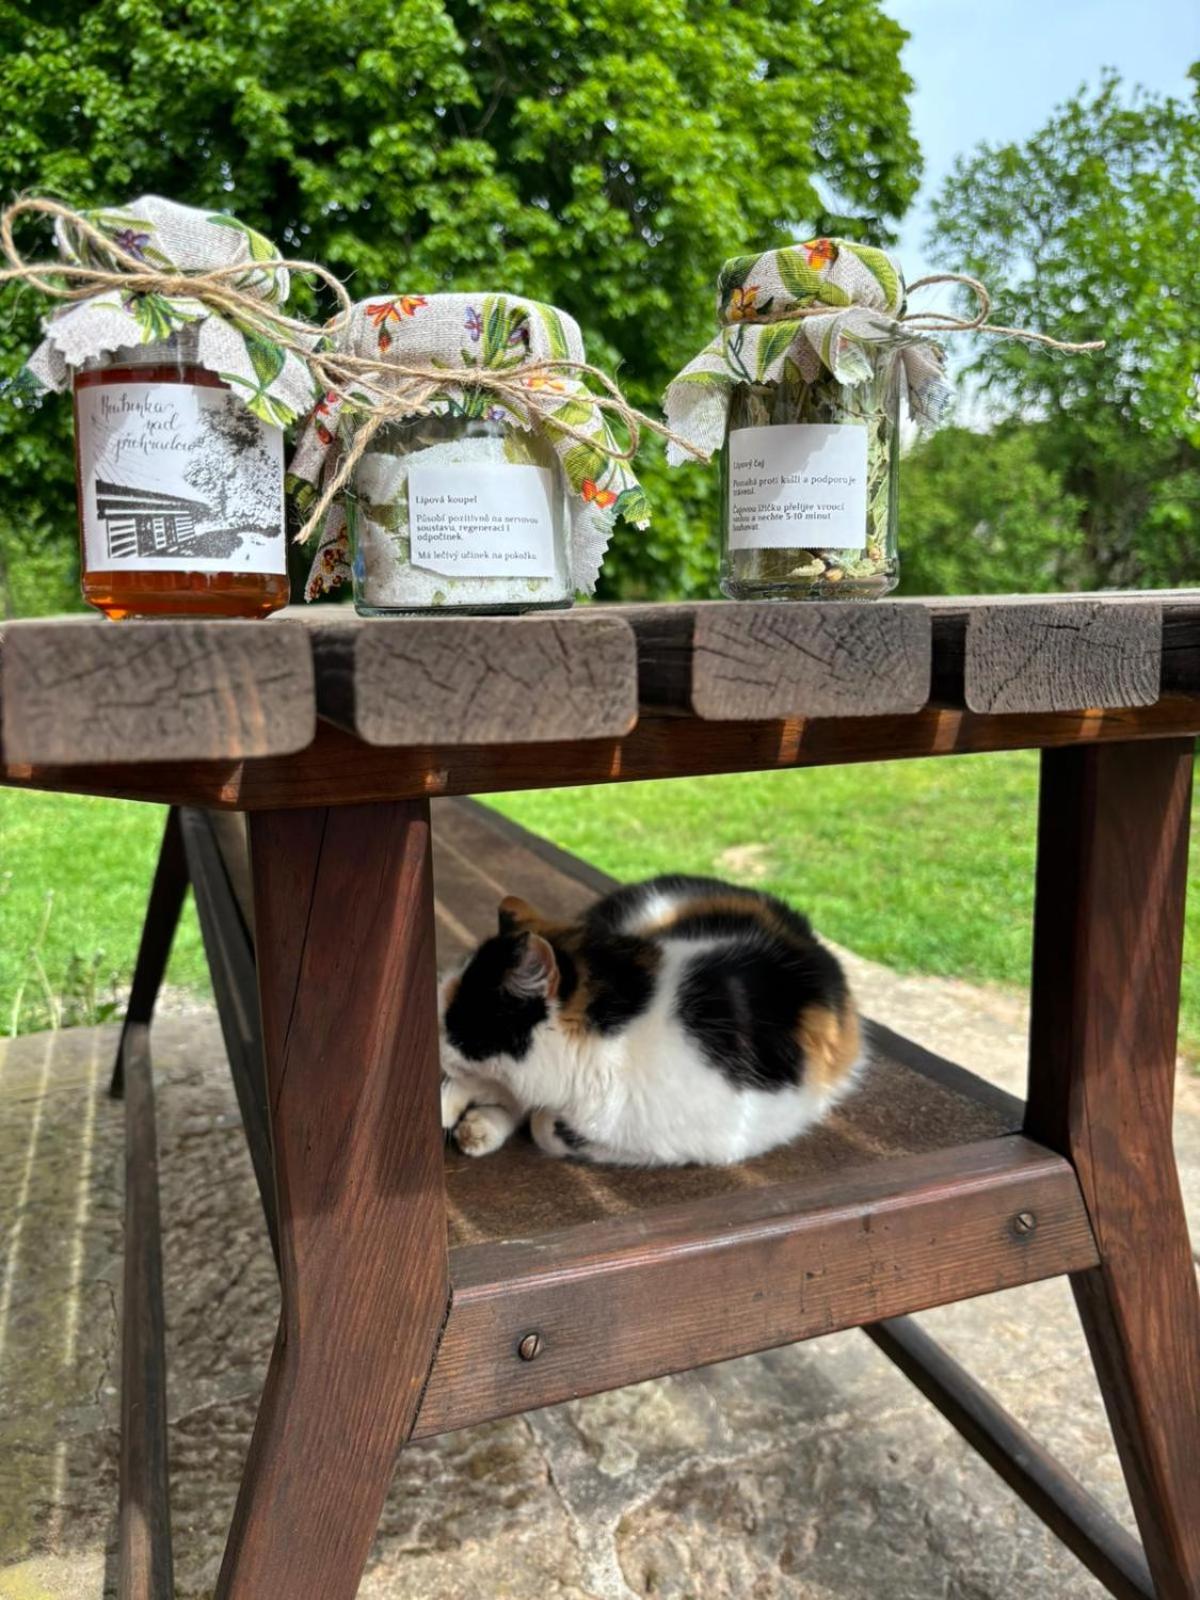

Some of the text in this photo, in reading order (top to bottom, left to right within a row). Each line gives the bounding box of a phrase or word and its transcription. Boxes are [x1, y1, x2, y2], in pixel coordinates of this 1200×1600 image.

[759, 477, 779, 487] proti
[811, 475, 856, 486] podporuje
[415, 495, 478, 506] Lipová koupel
[416, 513, 446, 523] Působí
[448, 513, 489, 524] pozitivně
[505, 516, 538, 524] nervovou
[758, 513, 783, 521] nechte
[786, 512, 803, 520] 5-10
[805, 512, 831, 520] minut
[459, 524, 505, 533] regeneraci
